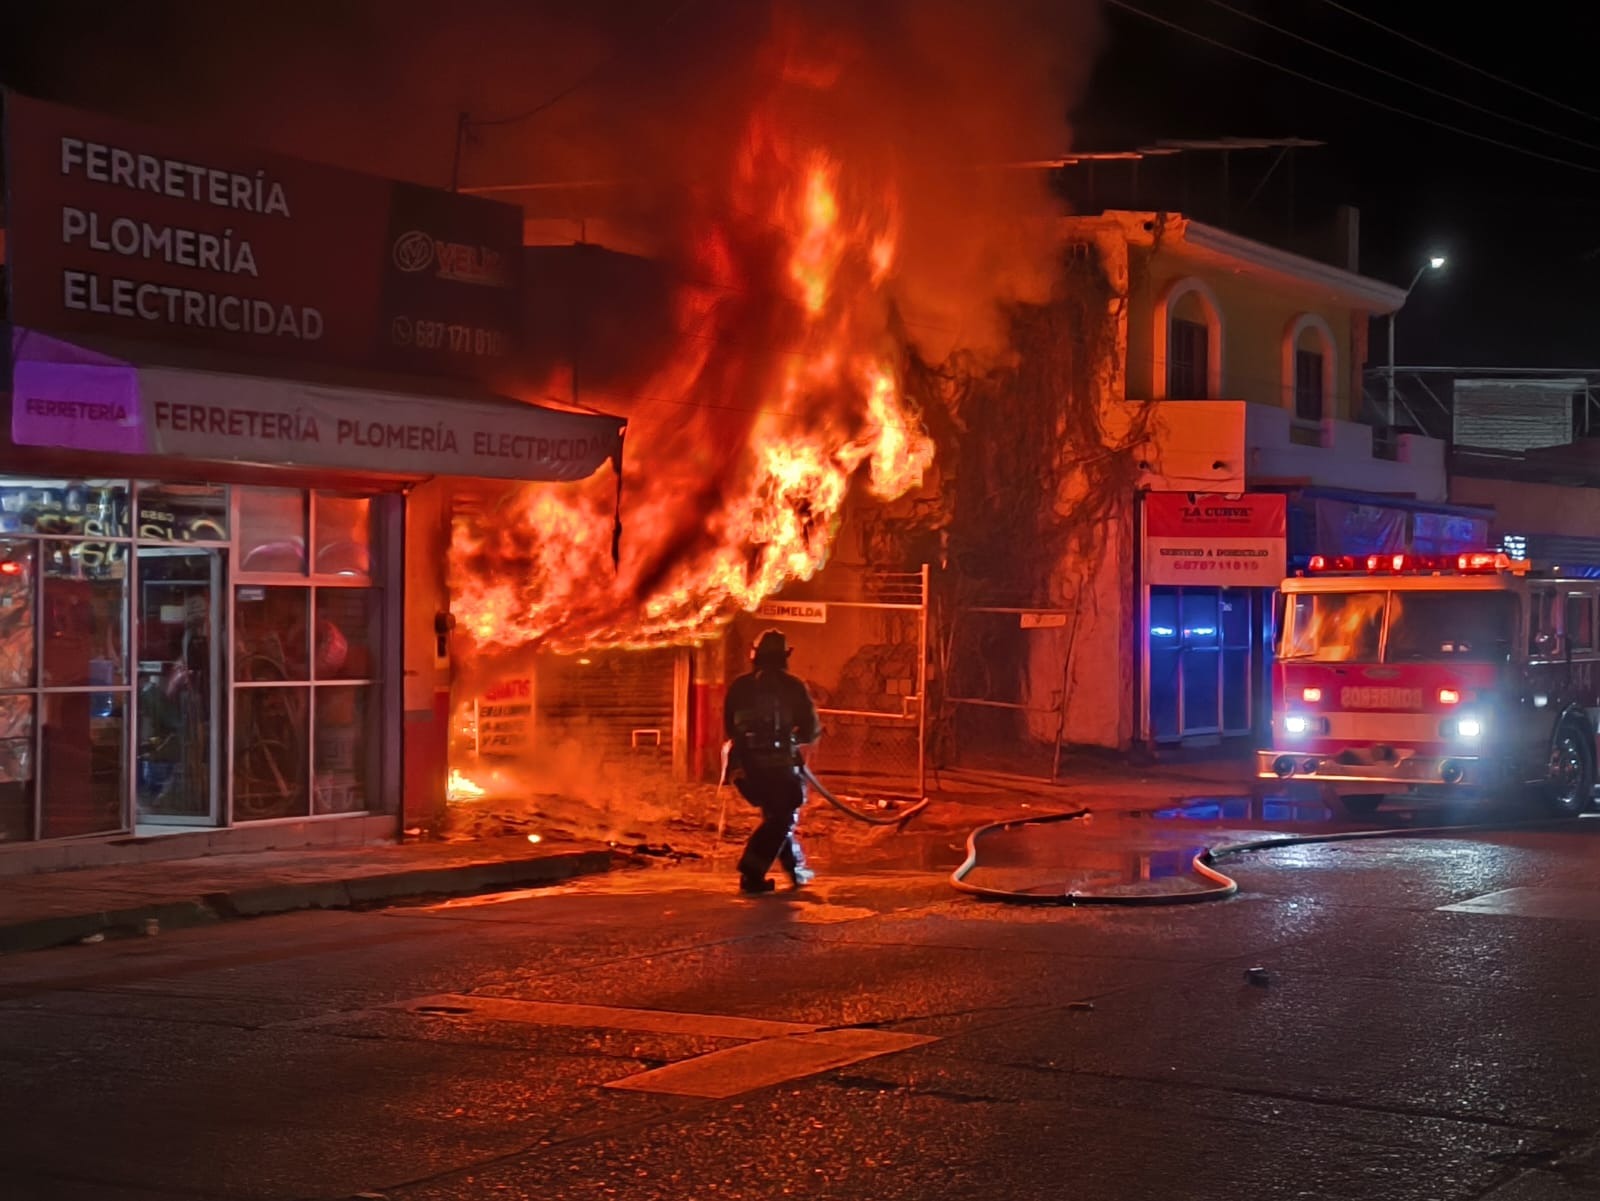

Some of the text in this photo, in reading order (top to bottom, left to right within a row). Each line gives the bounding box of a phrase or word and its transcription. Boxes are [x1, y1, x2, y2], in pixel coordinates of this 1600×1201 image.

[61, 137, 290, 218] FERRETERÍA
[62, 206, 258, 277] PLOMERÍA
[63, 270, 324, 341] ELECTRICIDAD
[26, 399, 128, 422] FERRETERÍA
[154, 402, 320, 443] FERRETERÍA
[336, 420, 459, 454] PLOMERÍA
